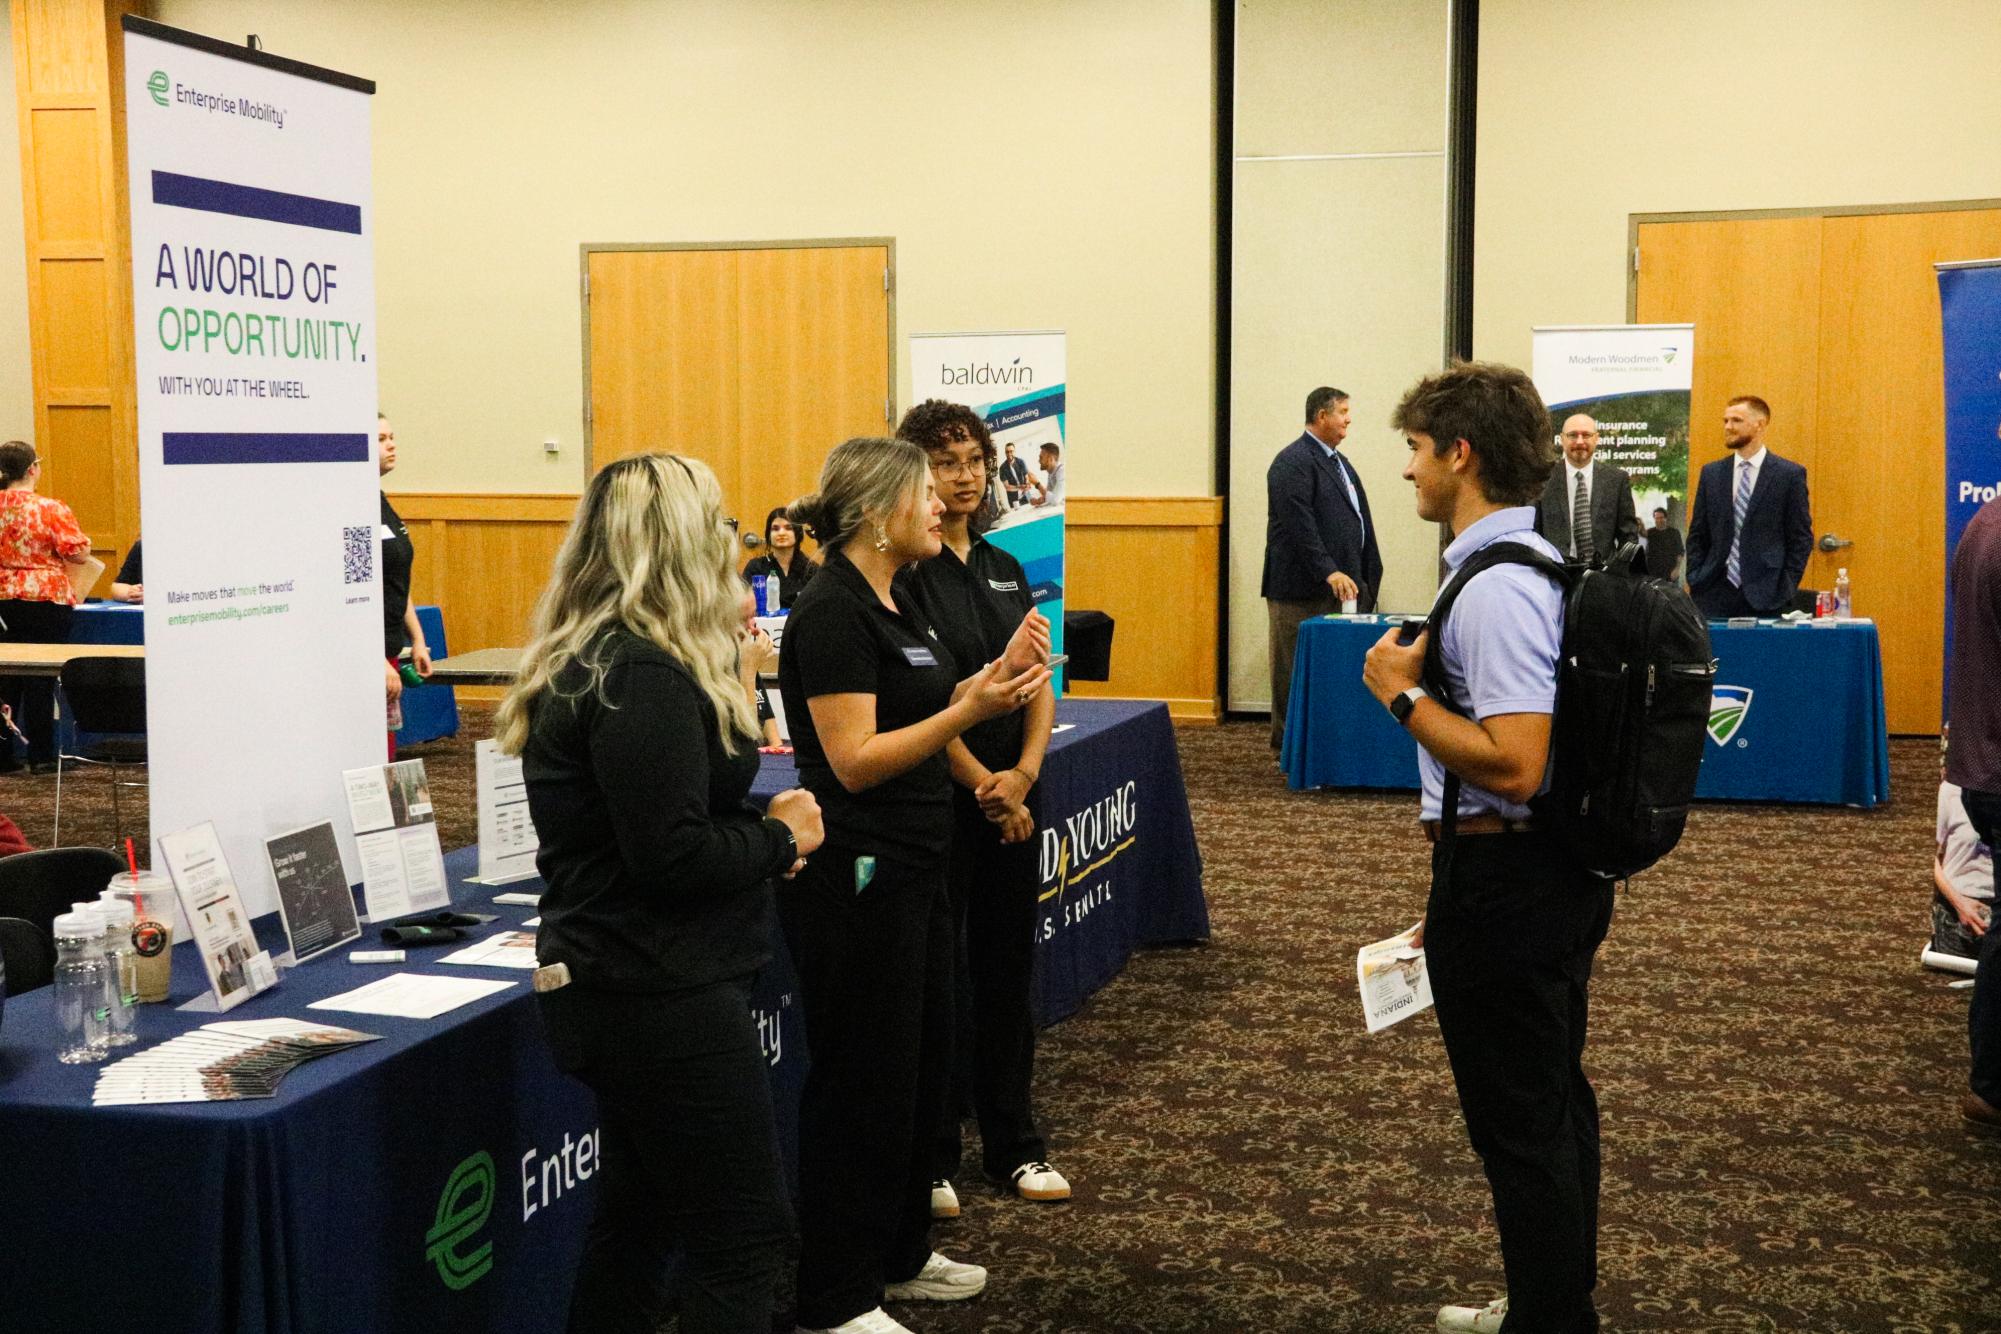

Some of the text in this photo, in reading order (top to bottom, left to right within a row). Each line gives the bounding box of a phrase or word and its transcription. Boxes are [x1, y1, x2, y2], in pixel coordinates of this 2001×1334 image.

[176, 83, 284, 129] Enterprise Mobility
[156, 243, 337, 304] A WORLD OF
[158, 306, 366, 363] OPPORTUNITY.
[1568, 354, 1659, 364] Modern Woodmen
[941, 357, 1032, 385] baldwin
[159, 376, 310, 399] WITH YOU AT THE WHEEL.
[1001, 408, 1039, 425] Accounting
[1616, 435, 1666, 447] planning
[1613, 450, 1657, 460] services
[1960, 481, 2001, 503] Pro
[167, 591, 190, 604] Make
[192, 590, 218, 600] moves
[220, 587, 236, 598] that
[238, 586, 257, 596] move
[259, 583, 272, 594] the
[168, 603, 289, 625] enterprisemobility.com/careers
[1066, 780, 1136, 868] YOUNG
[1373, 995, 1413, 1018] INDIANA
